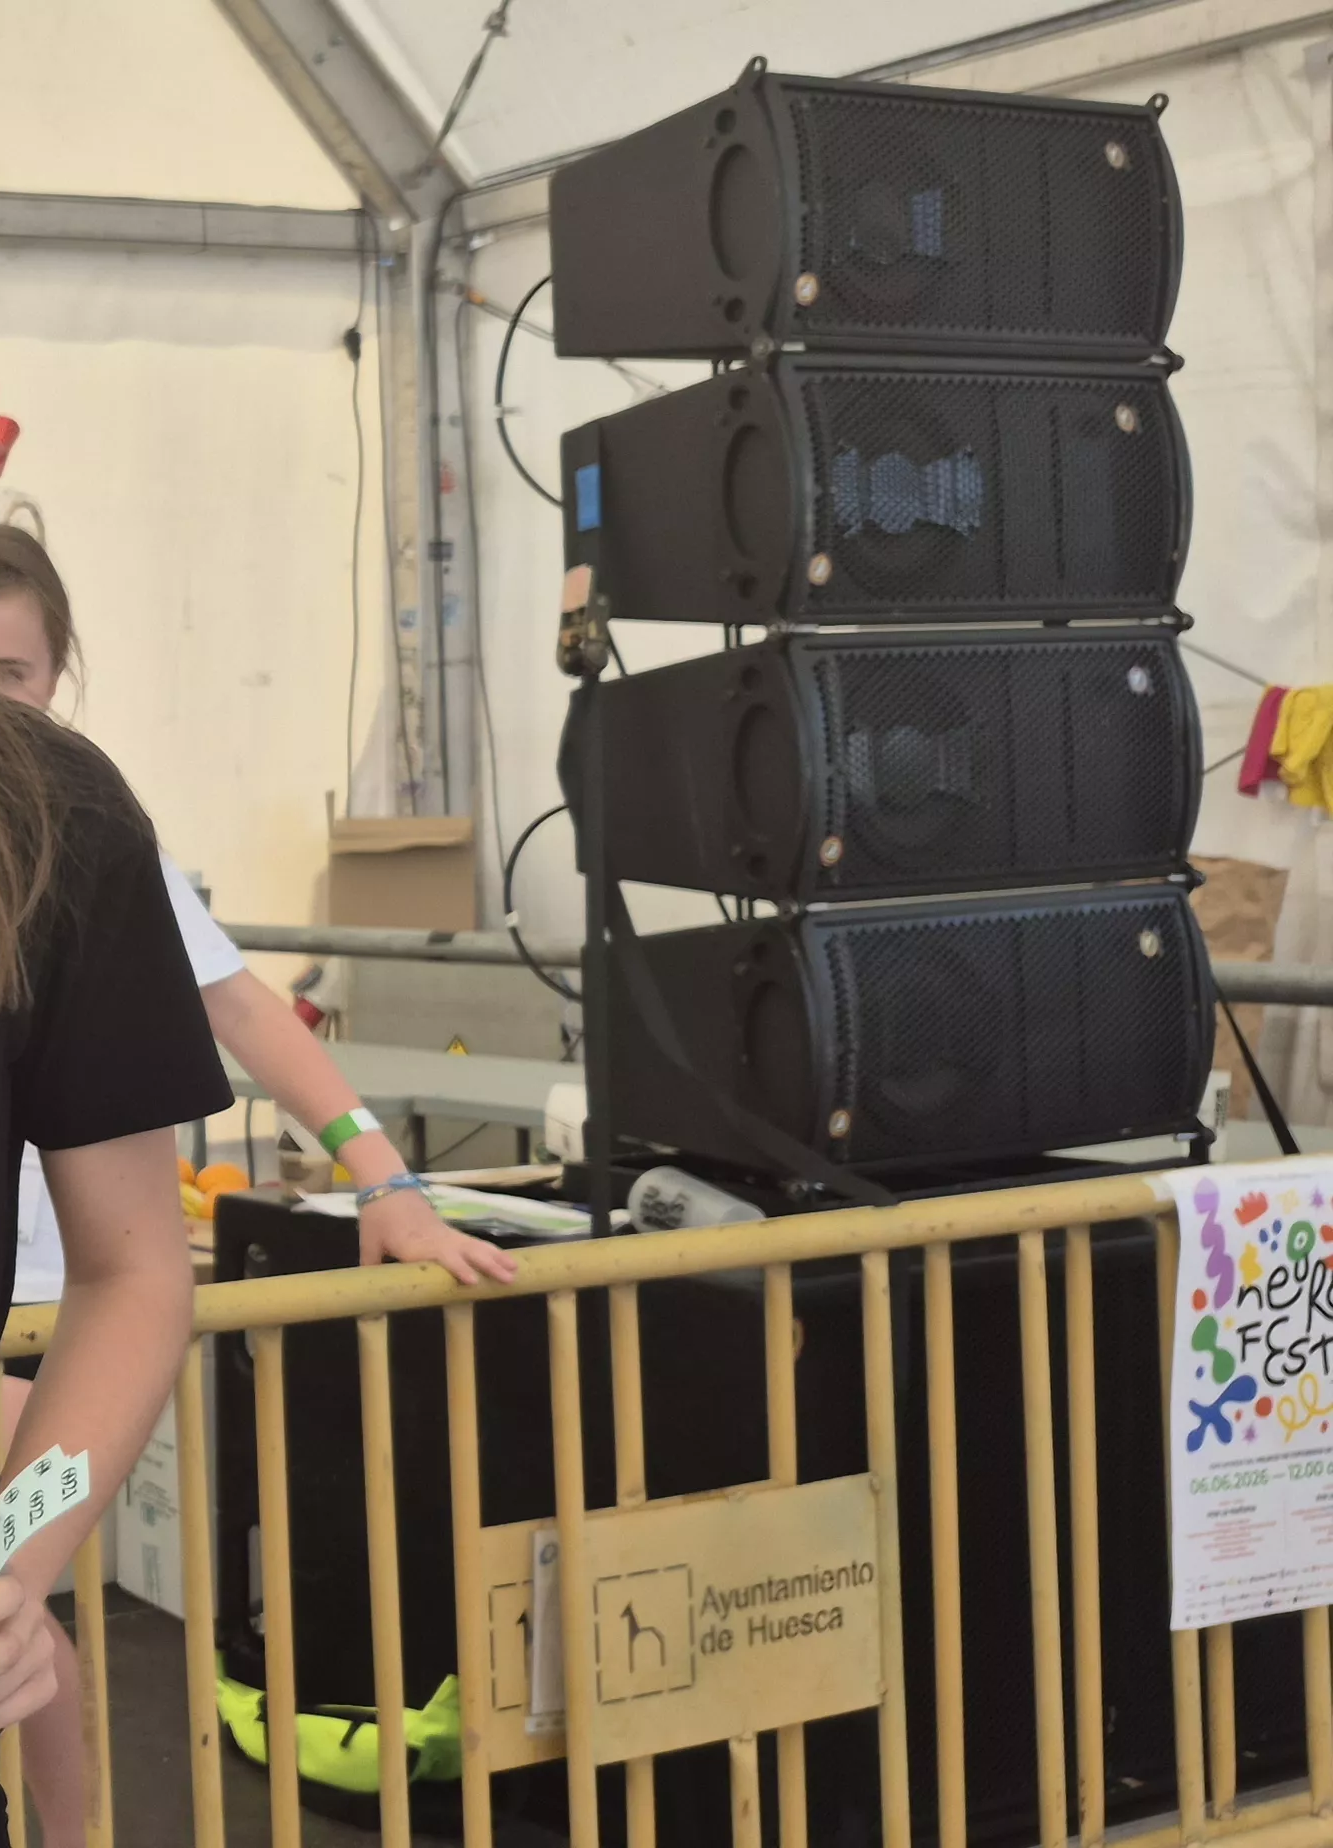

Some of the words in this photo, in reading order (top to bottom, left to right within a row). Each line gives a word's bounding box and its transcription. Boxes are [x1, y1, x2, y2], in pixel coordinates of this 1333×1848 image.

[700, 1560, 874, 1622] Ayuntamiento
[700, 1624, 733, 1656] de
[748, 1606, 843, 1646] Huesca
